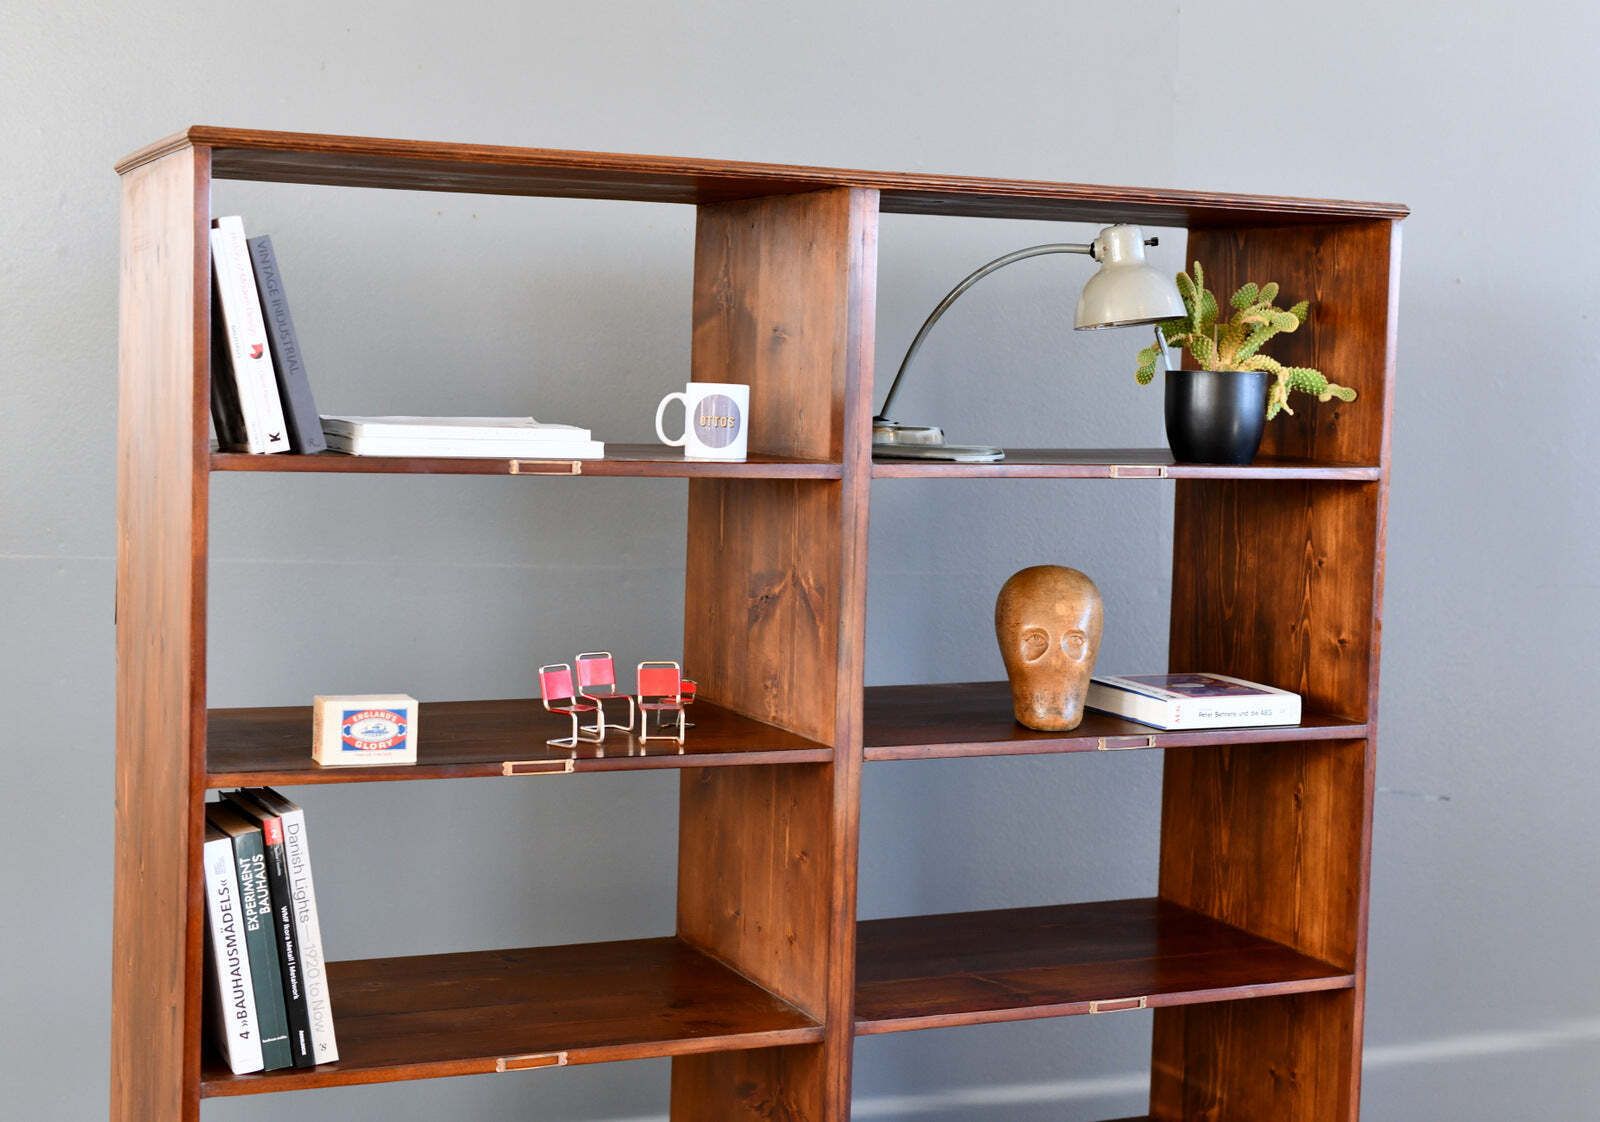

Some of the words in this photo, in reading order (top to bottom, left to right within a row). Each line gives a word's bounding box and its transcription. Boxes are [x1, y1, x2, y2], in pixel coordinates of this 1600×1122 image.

[257, 240, 280, 296] VINTAGE
[272, 299, 299, 375] INDUSTRIAL
[700, 415, 735, 428] OTTOS
[352, 711, 397, 722] ENGLAND'S
[354, 740, 393, 750] GLORY
[287, 823, 305, 874] Danish
[240, 858, 260, 931] EXPERIMENT
[252, 854, 271, 914] BAUHAUS
[281, 905, 290, 924] WMF
[286, 940, 295, 962] Metall
[289, 965, 300, 1000] Metalwork
[310, 982, 321, 997] to
[312, 1000, 326, 1032] Now
[240, 1031, 250, 1039] 4
